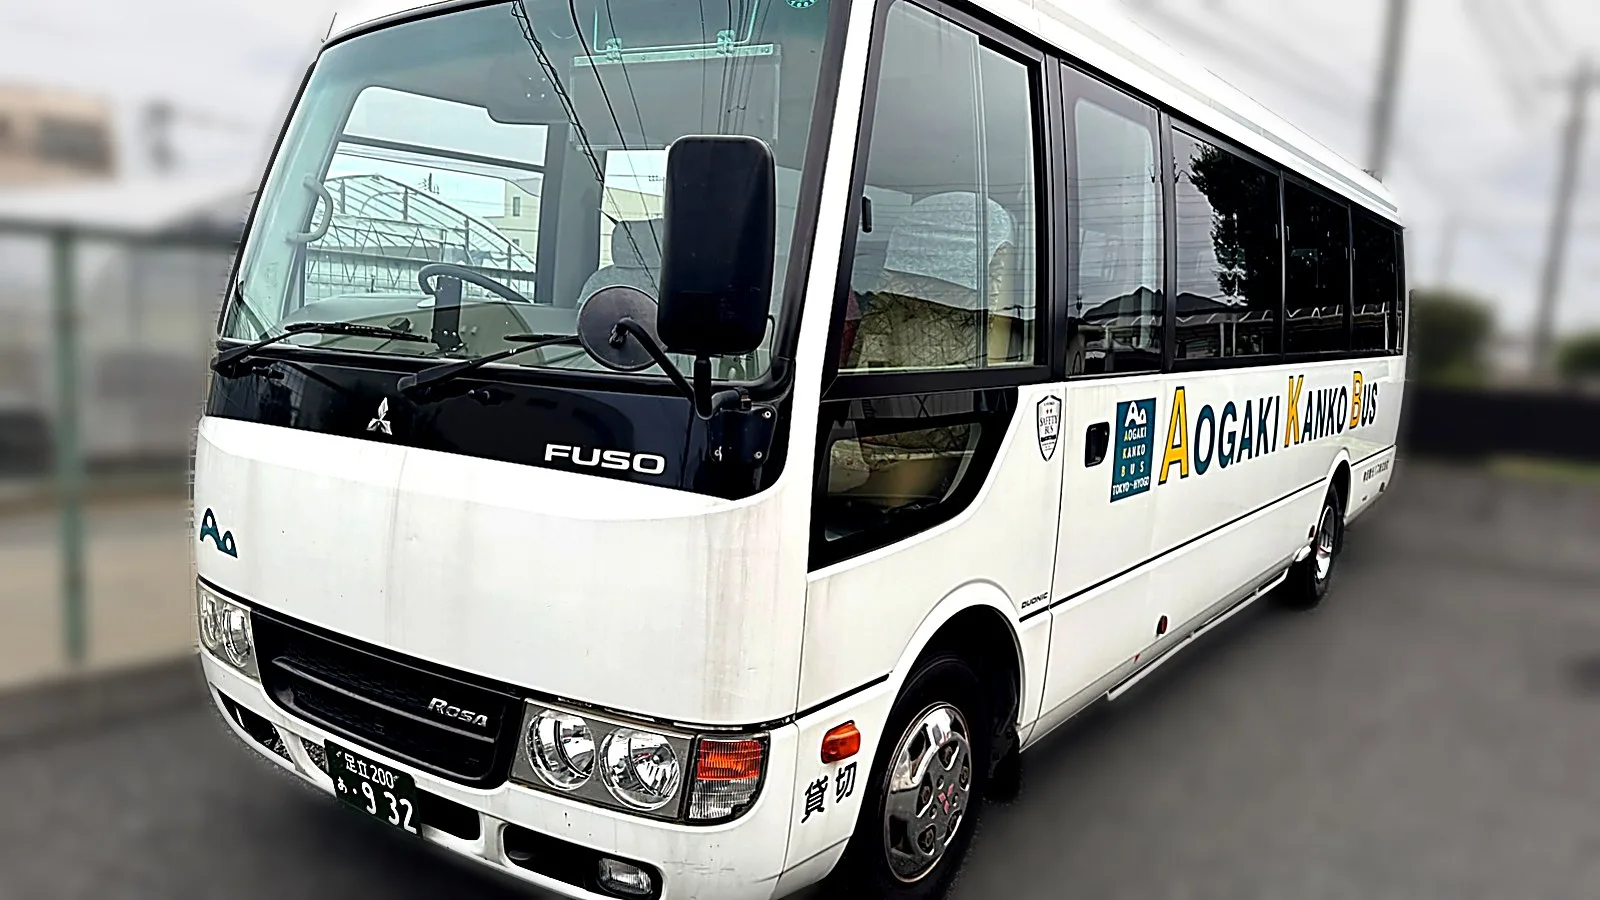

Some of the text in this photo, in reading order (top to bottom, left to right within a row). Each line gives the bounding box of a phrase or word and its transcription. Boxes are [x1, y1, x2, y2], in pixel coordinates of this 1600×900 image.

[1123, 426, 1147, 442] AOGAKI
[1158, 371, 1378, 485] AOGAKI KANKO BUS
[545, 444, 665, 474] FUSO
[1122, 443, 1146, 460] KANKO
[1021, 591, 1049, 609] DUONIC
[427, 698, 488, 728] ROSA
[801, 761, 857, 823] 貸切
